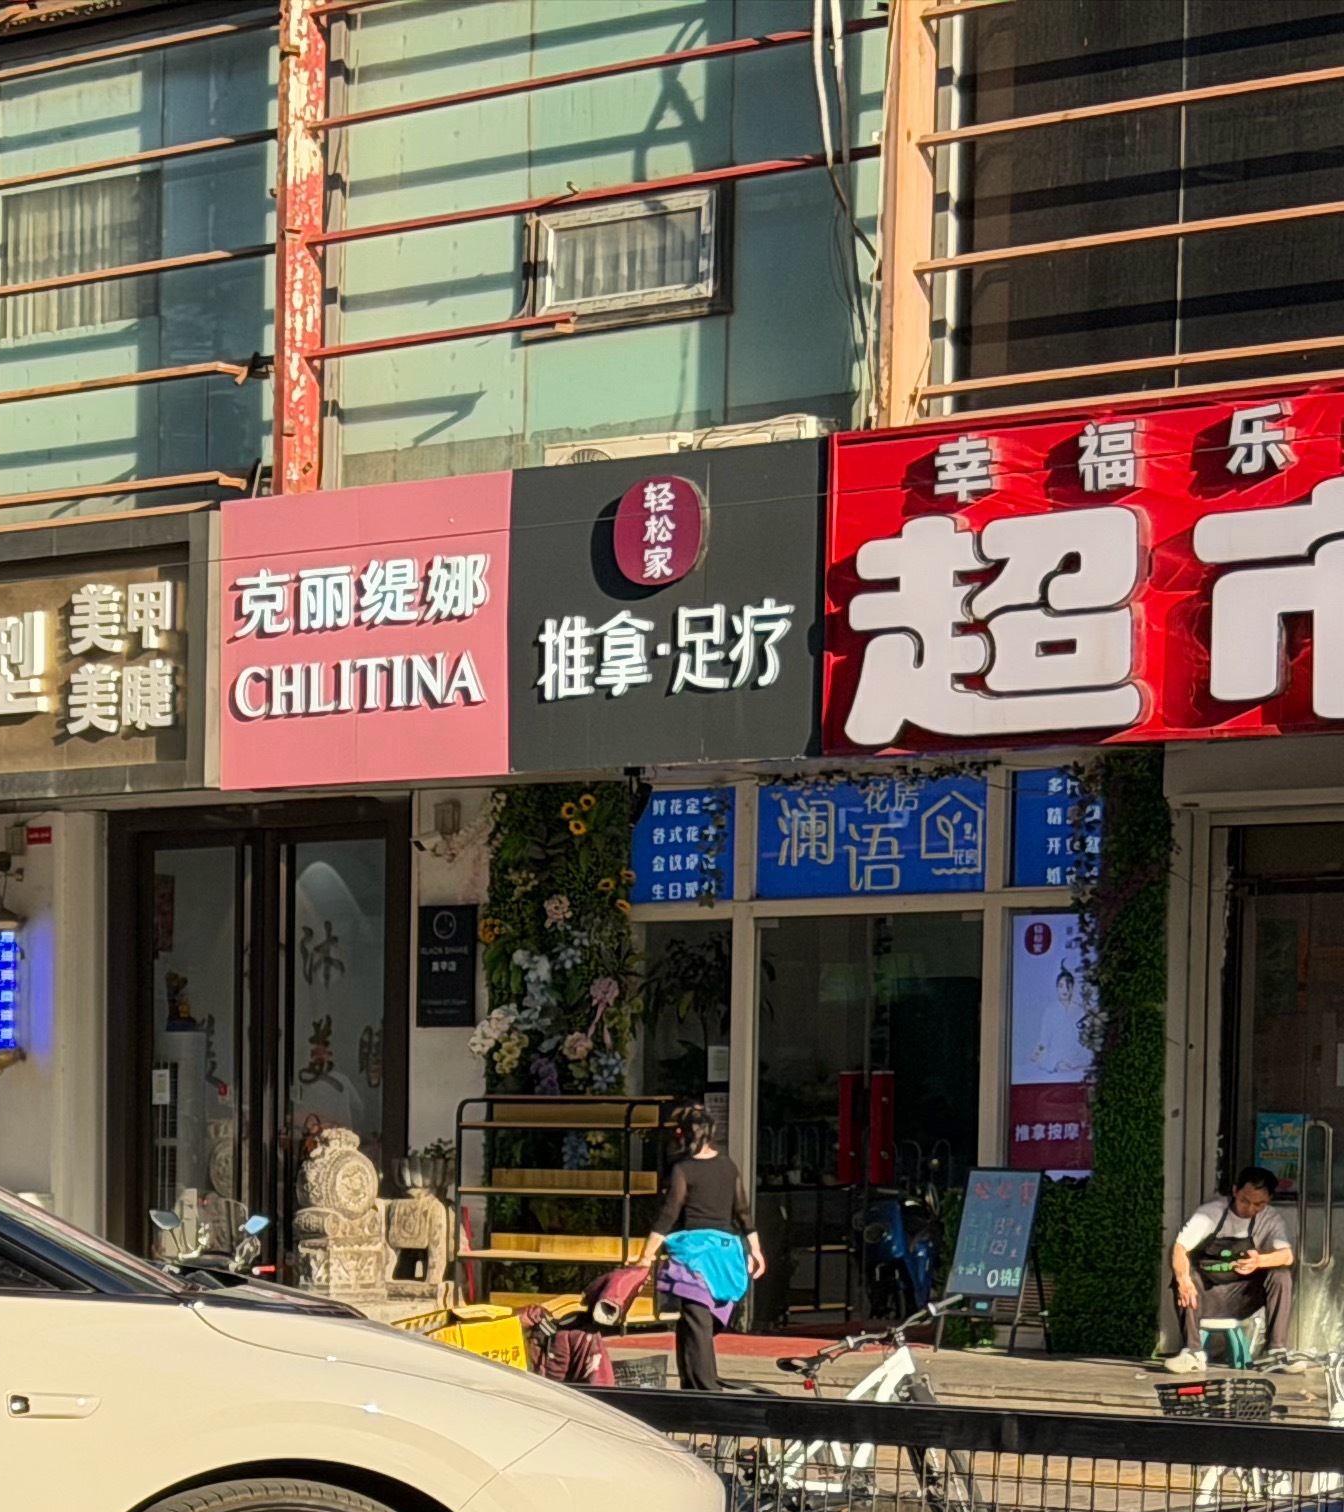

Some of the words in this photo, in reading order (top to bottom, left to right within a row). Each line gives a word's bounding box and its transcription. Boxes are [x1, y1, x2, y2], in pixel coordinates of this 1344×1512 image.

[934, 404, 1292, 502] 幸福乐
[643, 481, 676, 580] 轻松家
[69, 581, 172, 655] 美甲
[235, 552, 490, 638] 克丽缇娜
[67, 659, 172, 734] 美睫
[235, 651, 486, 719] CHLITINA
